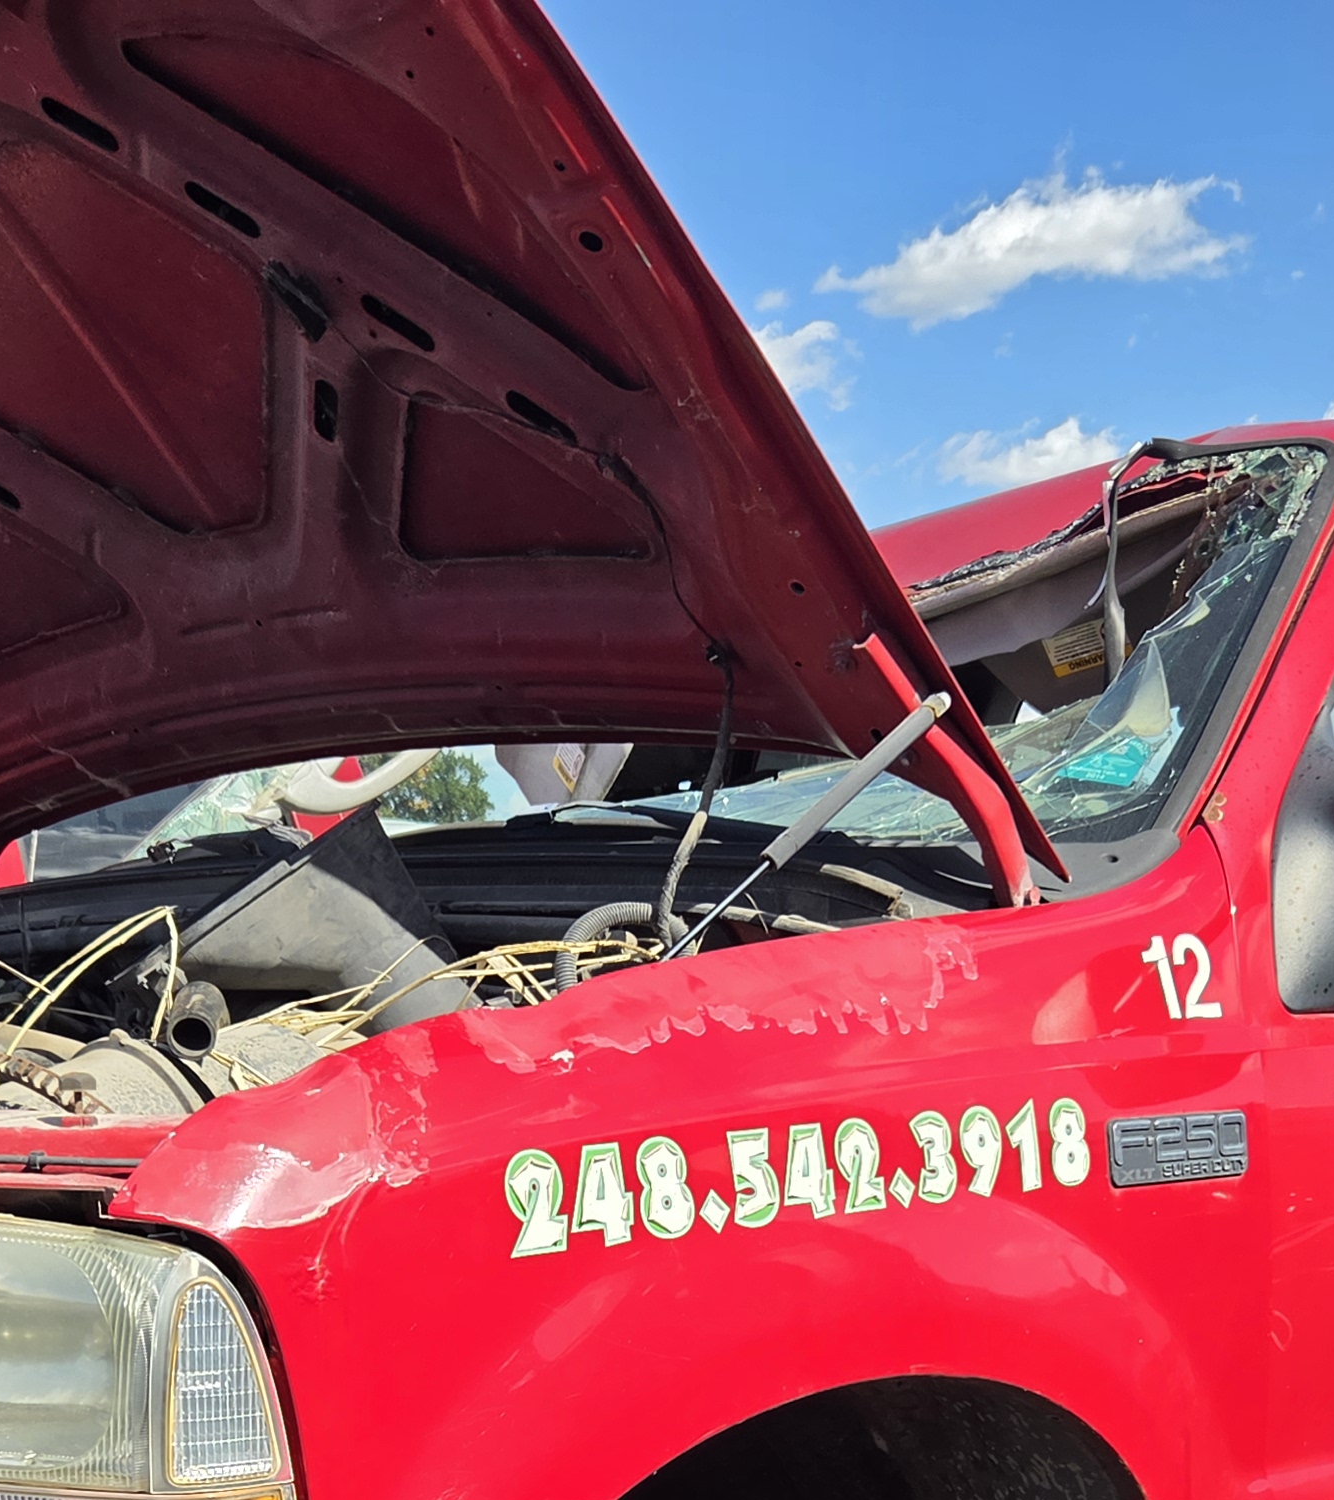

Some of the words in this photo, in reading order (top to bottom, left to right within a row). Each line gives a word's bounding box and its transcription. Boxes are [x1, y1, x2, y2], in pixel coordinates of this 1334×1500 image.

[1068, 652, 1104, 670] ARNING
[1142, 932, 1223, 1020] 12
[504, 1097, 1091, 1260] 248.542.3918
[1120, 1167, 1157, 1183] XLT
[1162, 1162, 1209, 1178] SUPER
[1211, 1157, 1247, 1173] DUTY
